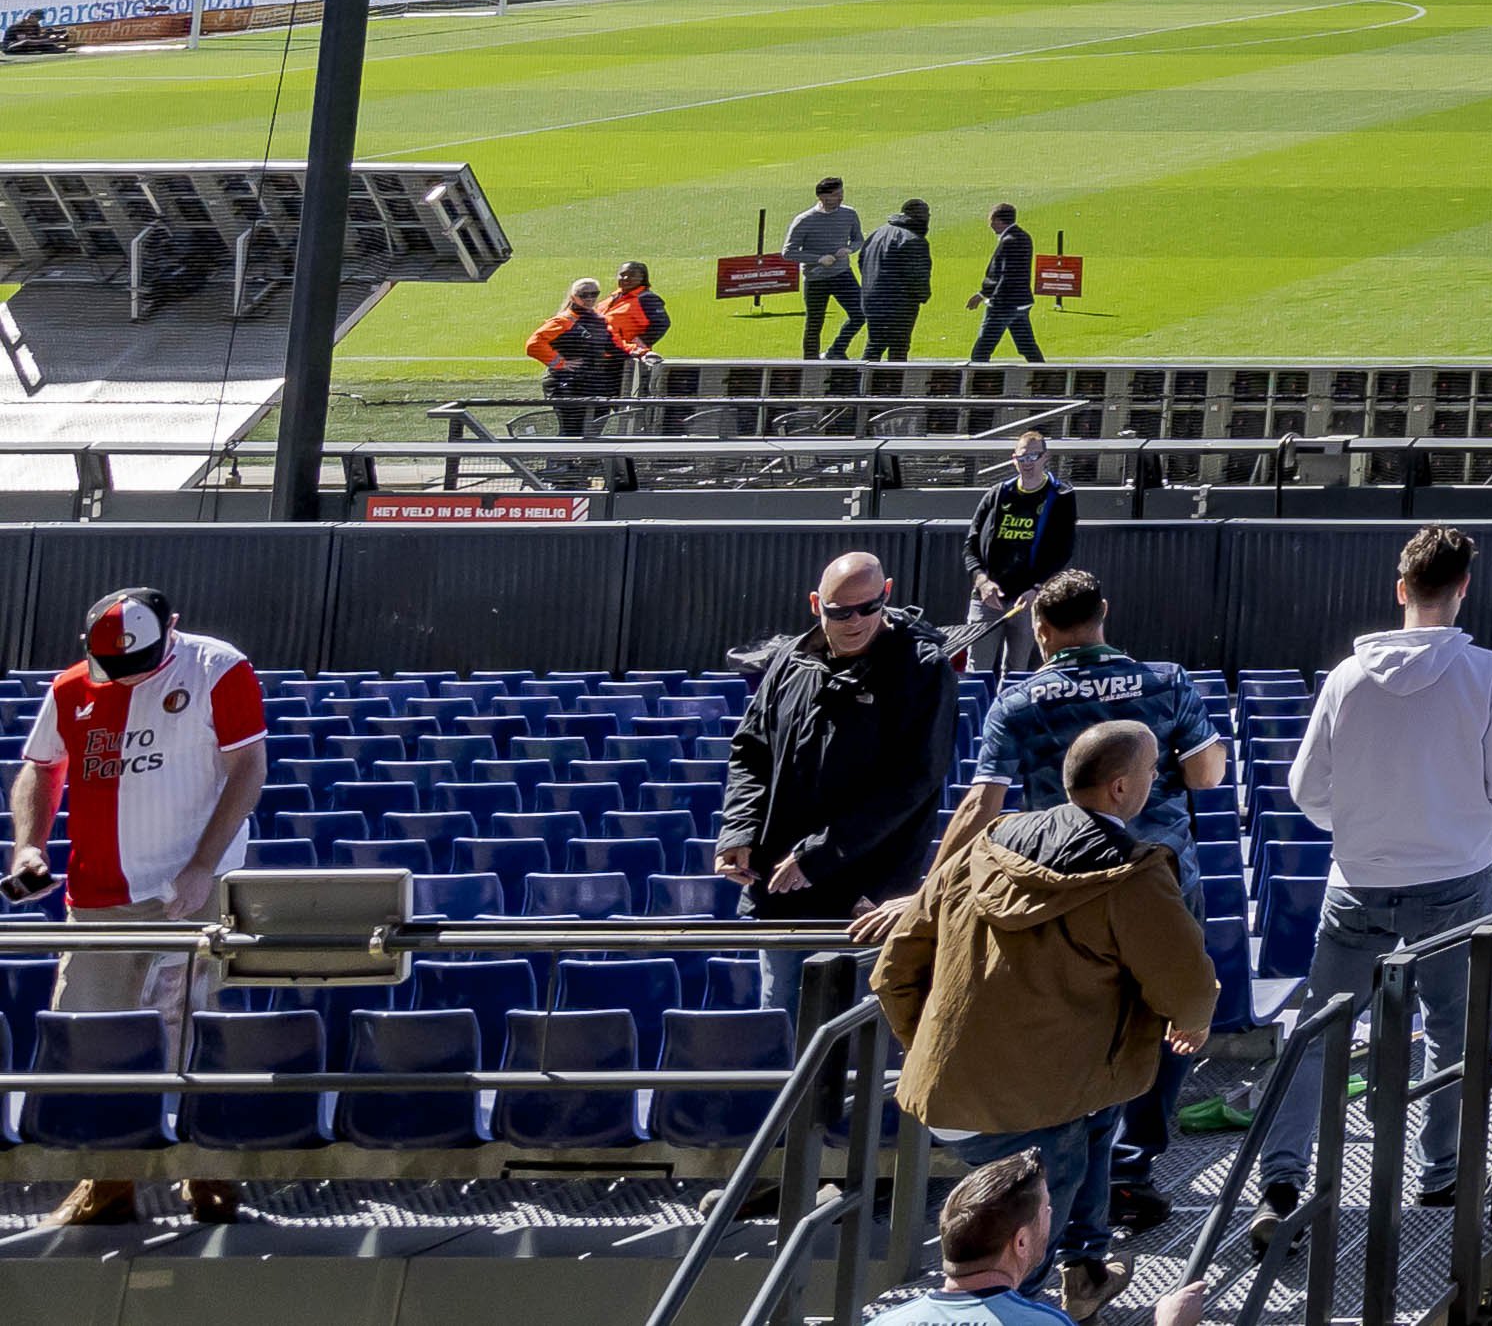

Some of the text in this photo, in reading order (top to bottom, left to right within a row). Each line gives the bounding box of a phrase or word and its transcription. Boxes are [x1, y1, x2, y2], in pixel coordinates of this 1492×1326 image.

[372, 507, 566, 519] HET VELD IN DE KUIP IS HEILIG
[1001, 513, 1035, 528] Euro
[996, 526, 1036, 540] Parcs
[85, 728, 155, 754] Euro
[82, 749, 164, 780] Parcs
